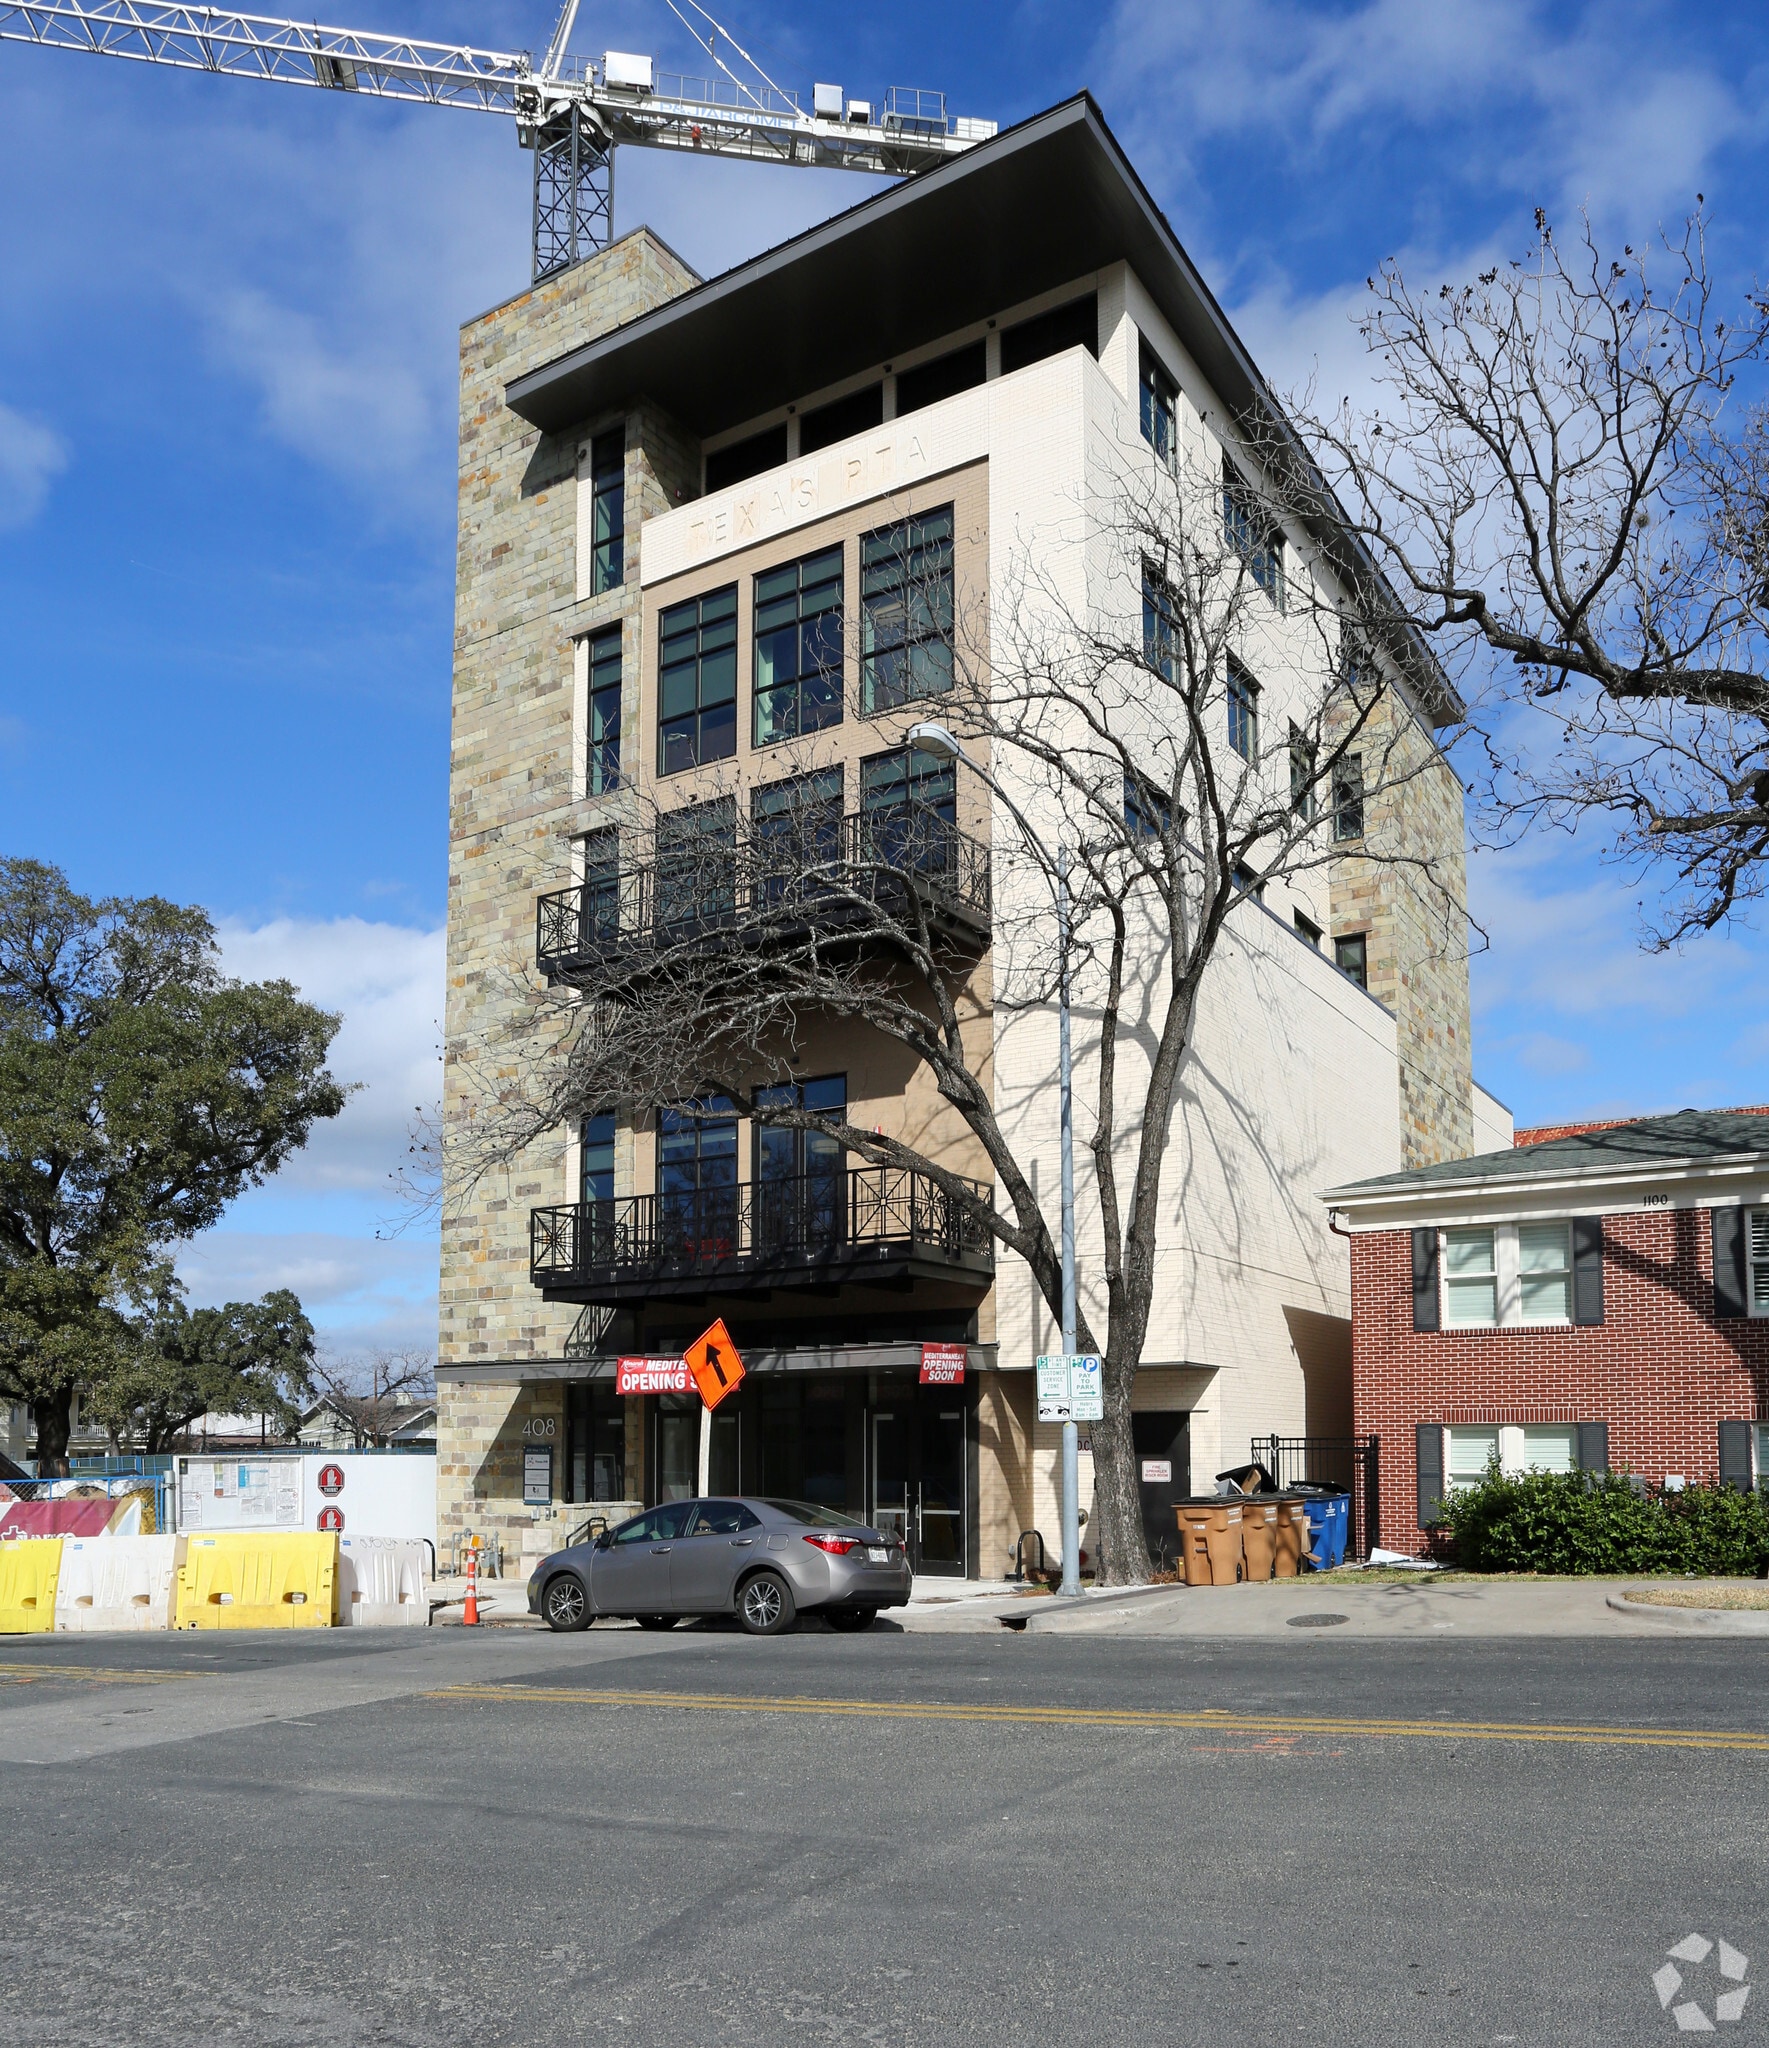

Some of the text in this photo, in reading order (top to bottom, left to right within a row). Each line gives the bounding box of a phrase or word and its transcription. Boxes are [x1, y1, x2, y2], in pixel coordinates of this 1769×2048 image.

[690, 436, 927, 552] TEXAS PTA
[1643, 1194, 1668, 1207] 1100
[924, 1352, 964, 1360] MEDITERRANEAN
[923, 1360, 964, 1370] OPENING
[622, 1373, 686, 1391] OPENING
[928, 1371, 955, 1380] SOON
[522, 1418, 556, 1436] 408
